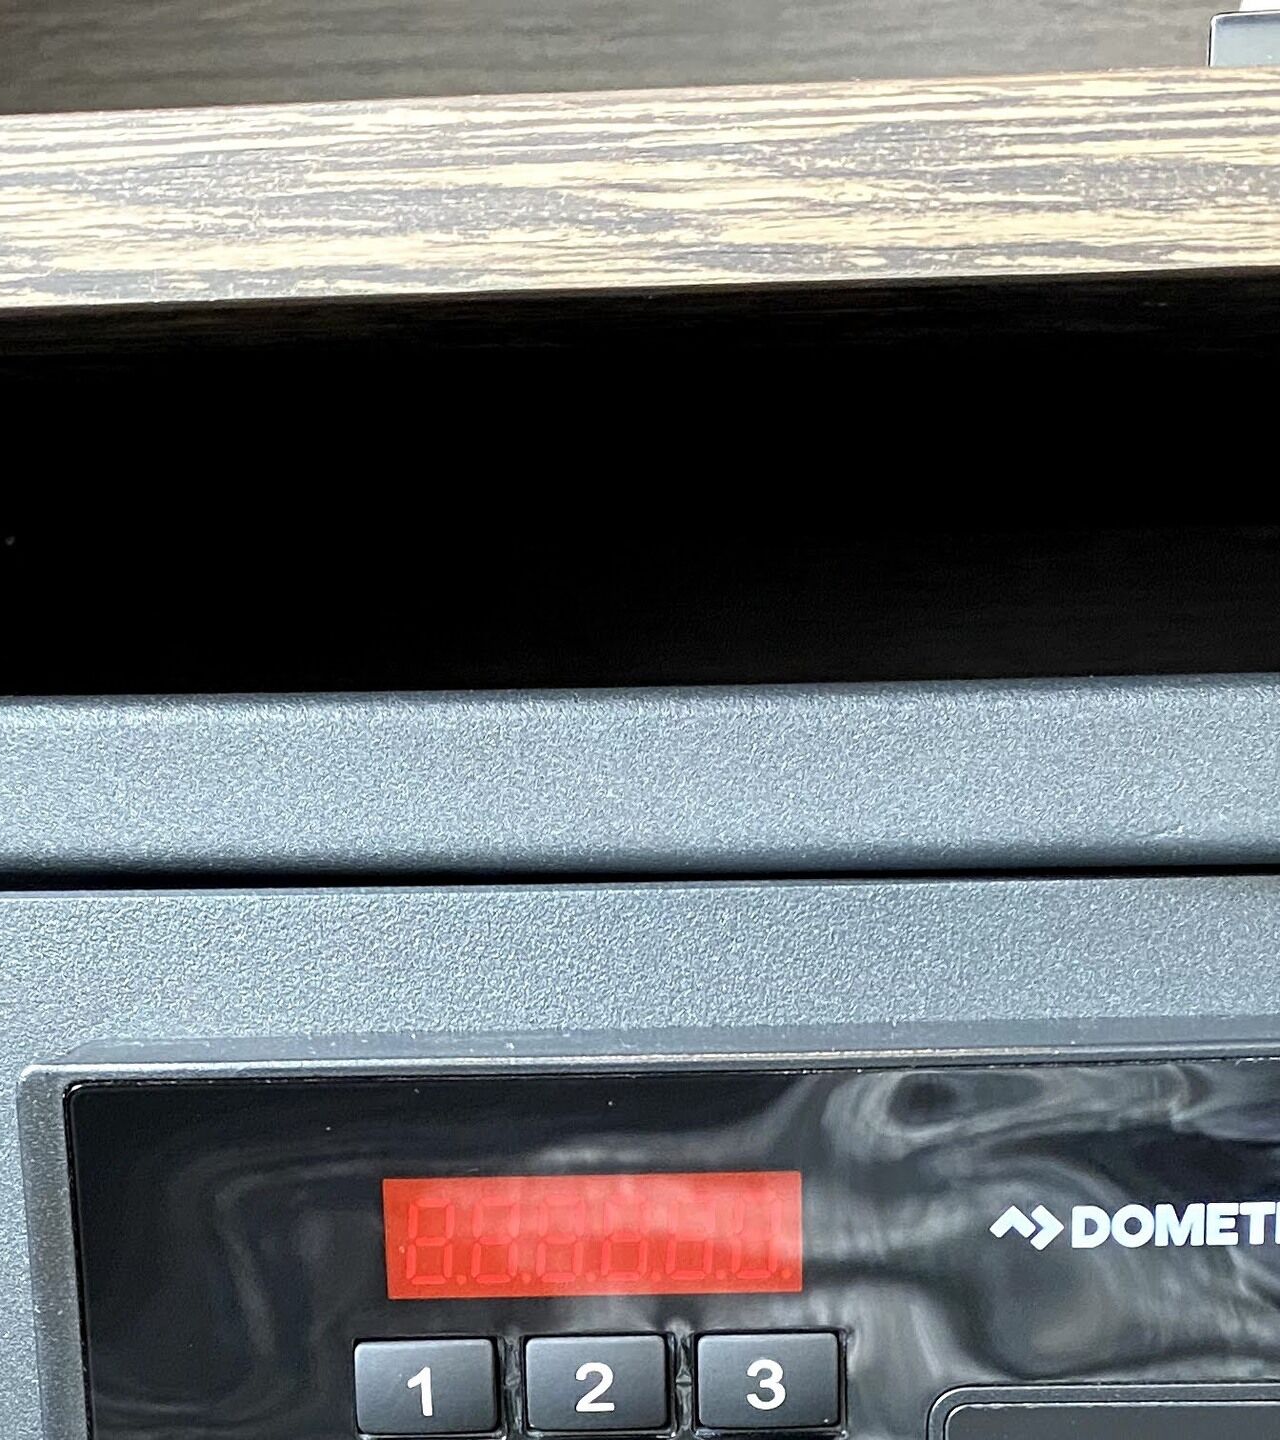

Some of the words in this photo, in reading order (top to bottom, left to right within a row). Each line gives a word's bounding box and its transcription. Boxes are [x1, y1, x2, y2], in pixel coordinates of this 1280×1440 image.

[407, 1366, 433, 1417] 1
[575, 1361, 615, 1412] 2
[746, 1356, 786, 1410] 3
